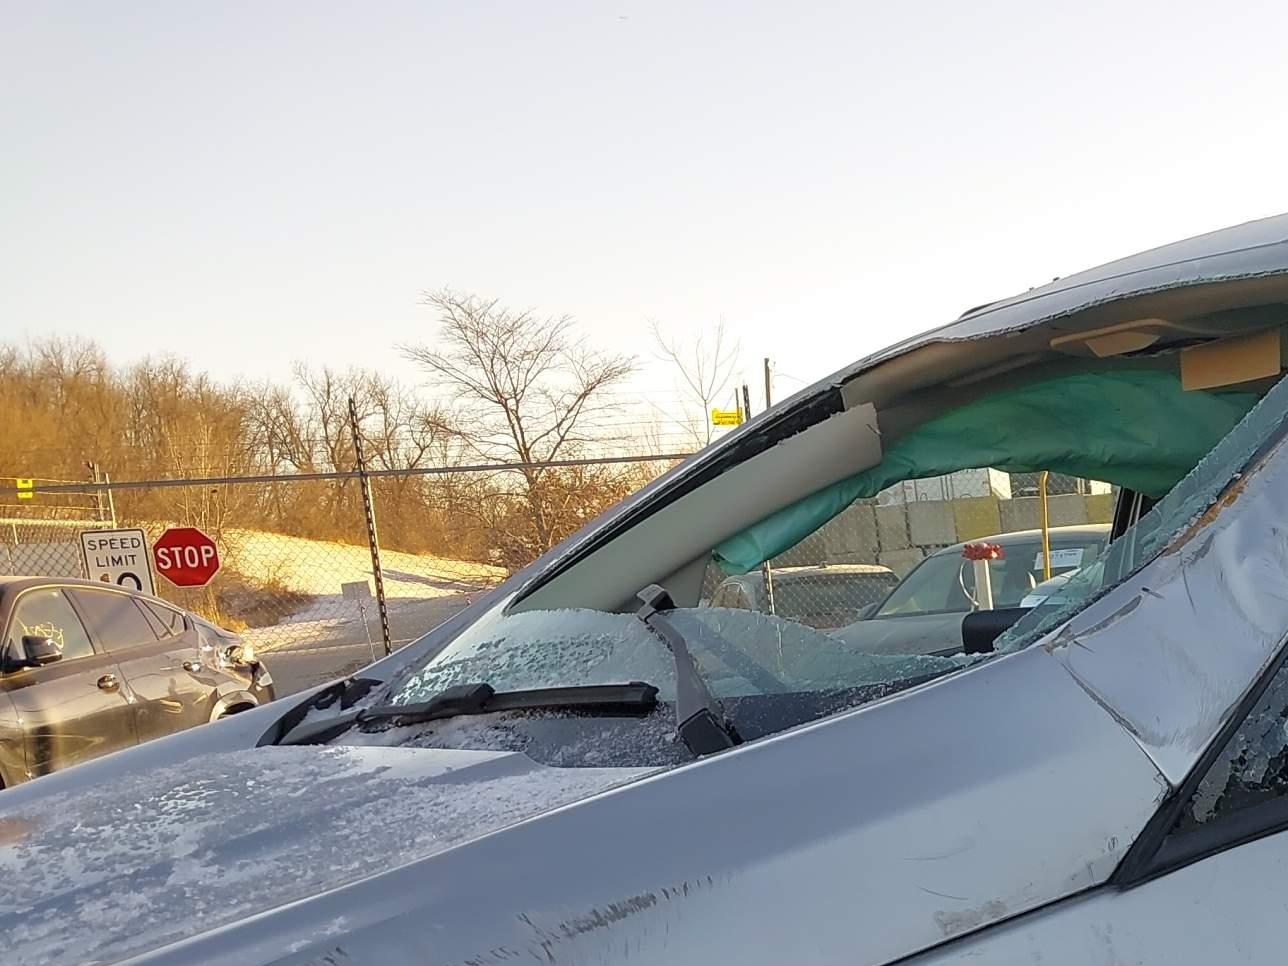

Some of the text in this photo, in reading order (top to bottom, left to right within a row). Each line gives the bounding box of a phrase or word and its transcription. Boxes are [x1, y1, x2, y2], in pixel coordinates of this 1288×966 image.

[87, 537, 141, 551] SPEED
[96, 554, 137, 567] LIMIT
[157, 545, 215, 570] STOP
